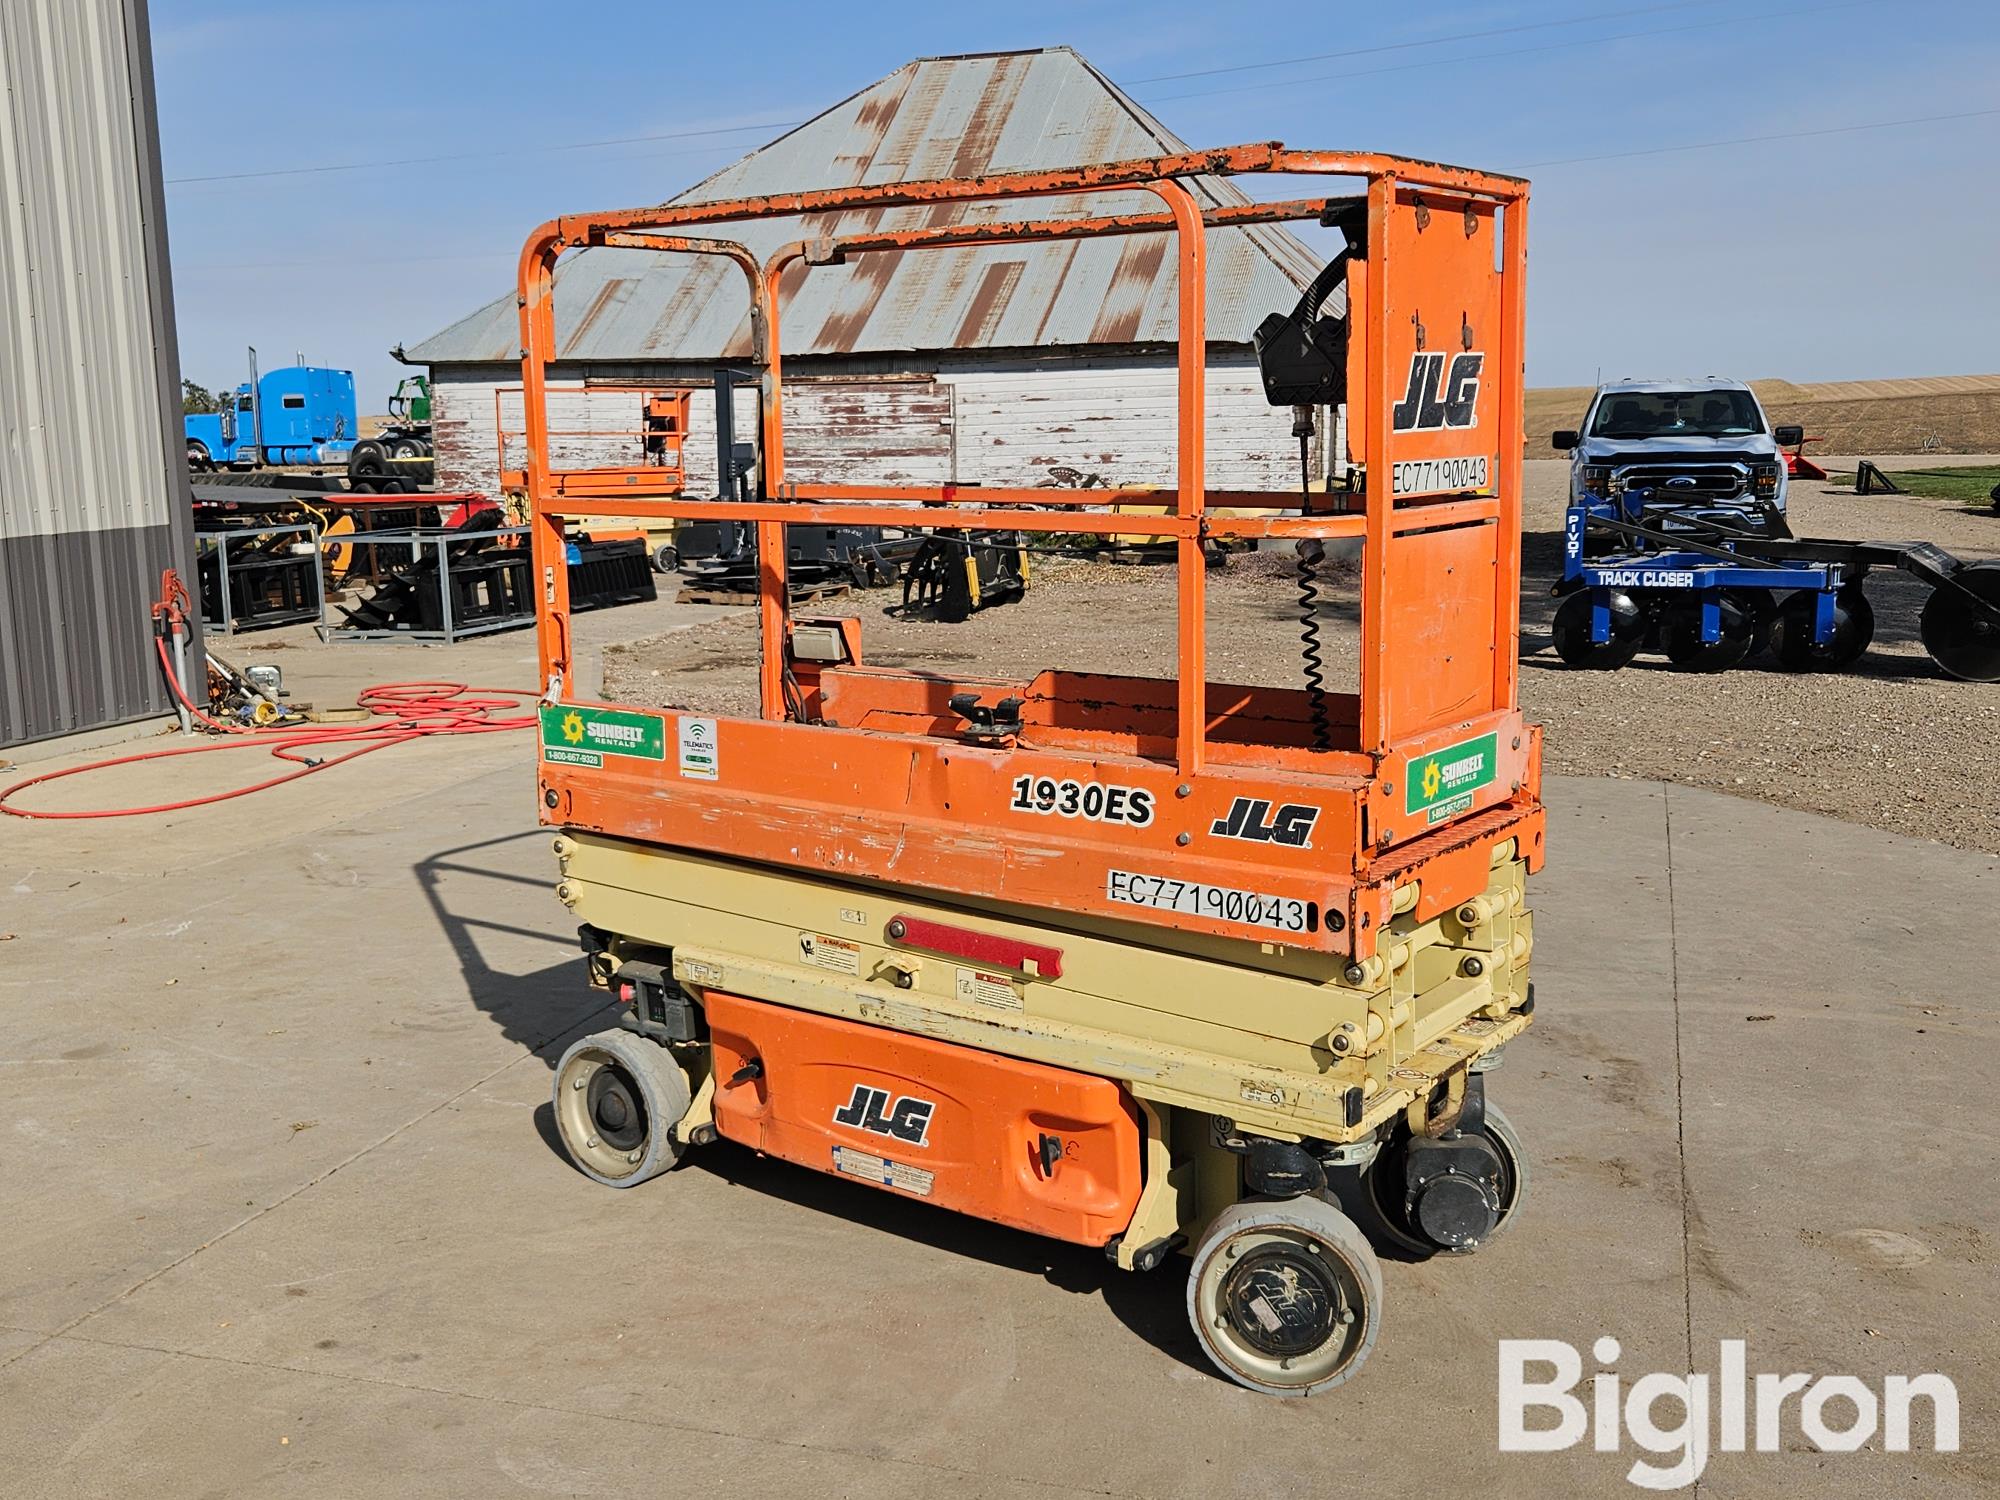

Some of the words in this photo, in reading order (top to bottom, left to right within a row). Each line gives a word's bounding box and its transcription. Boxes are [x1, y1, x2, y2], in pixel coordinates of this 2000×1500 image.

[1392, 353, 1485, 433] JLG
[1392, 458, 1486, 493] EC77190043
[1568, 515, 1579, 559] PIVOT
[1598, 571, 1639, 586] TRACK
[1643, 572, 1694, 587] CLOSER
[587, 722, 644, 742] SUNBELT
[595, 737, 636, 748] RENTALS
[683, 740, 714, 750] TELEMATICS
[1442, 753, 1484, 784] SUNBELT
[1447, 772, 1477, 789] RENTALS
[1012, 776, 1154, 826] 1930ES
[1210, 797, 1319, 847] JLG
[1111, 871, 1304, 931] EC77190043
[833, 1084, 935, 1146] JLG
